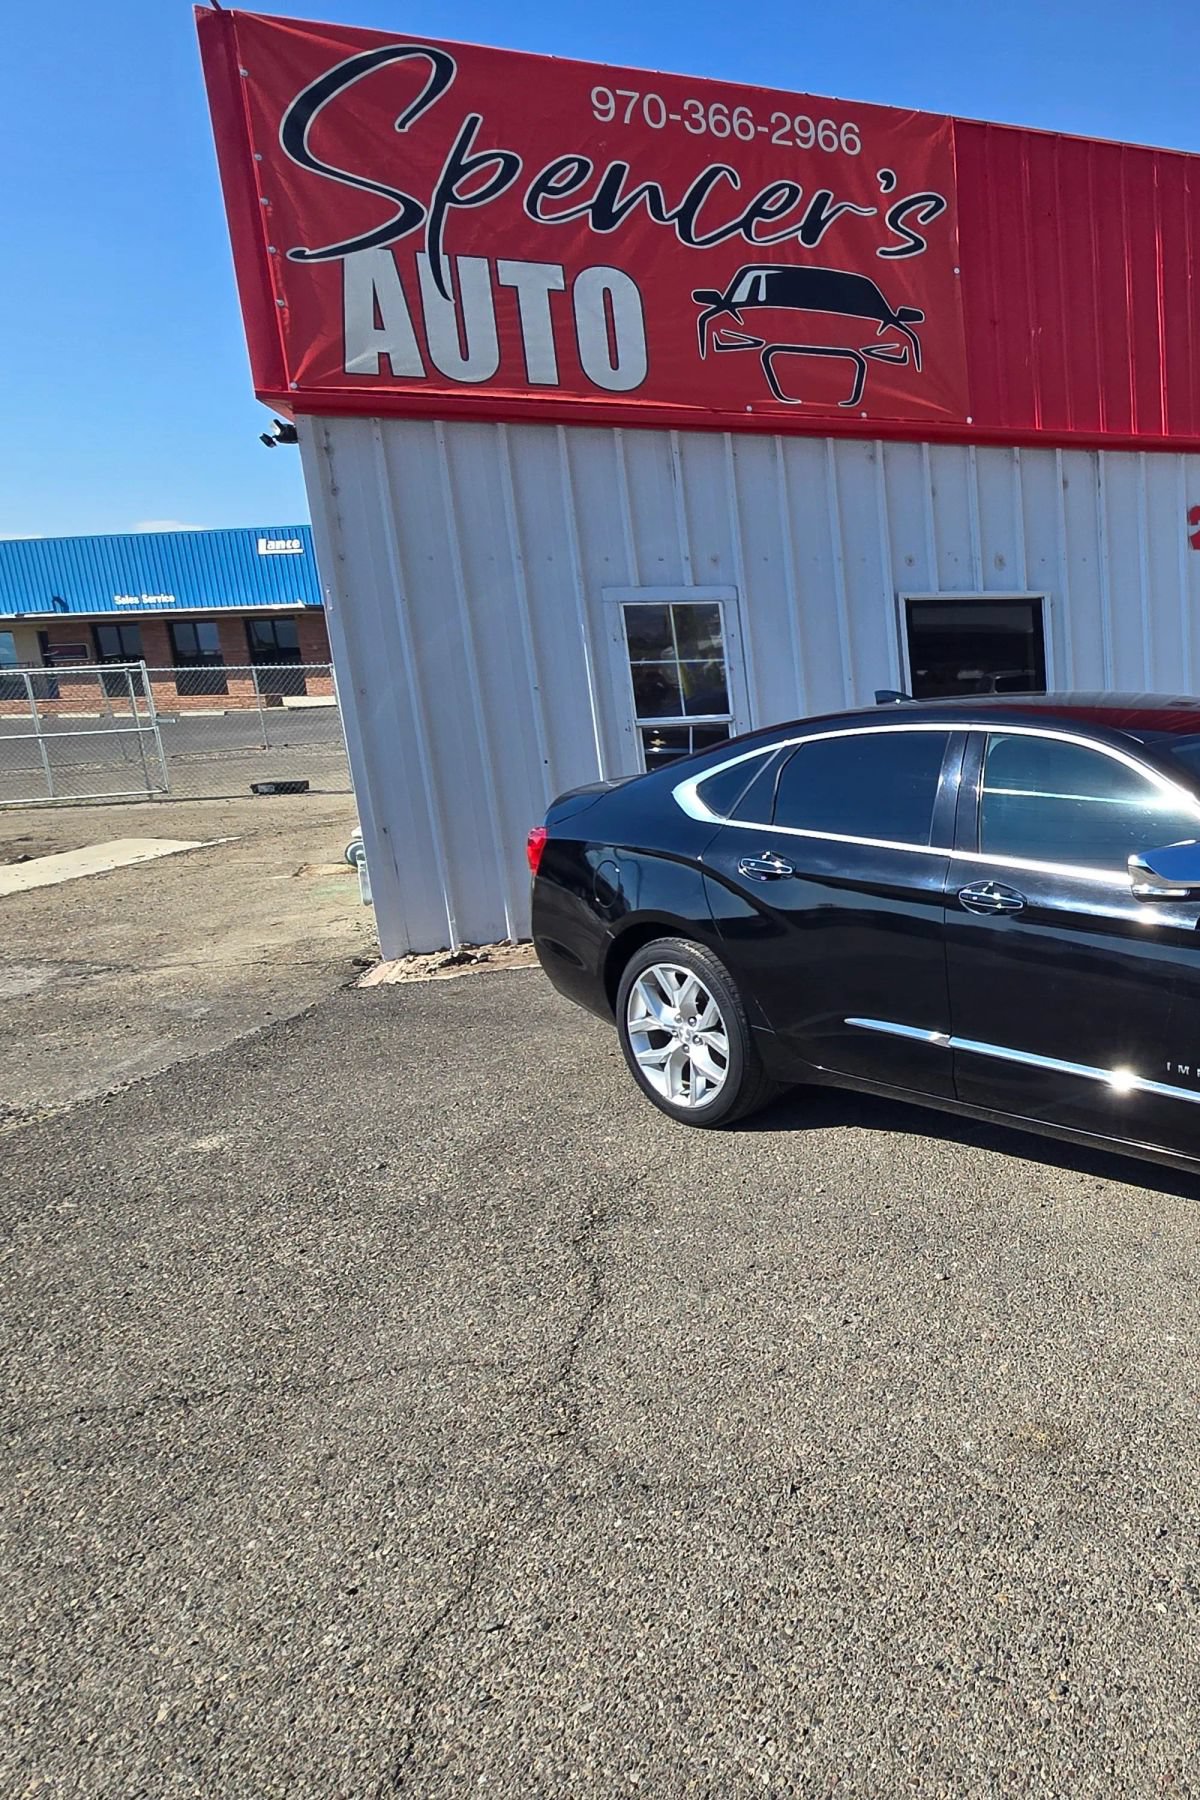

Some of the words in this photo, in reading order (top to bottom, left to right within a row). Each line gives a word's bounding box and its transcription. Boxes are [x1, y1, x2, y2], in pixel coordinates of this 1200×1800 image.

[590, 86, 862, 157] 970-366-2966
[279, 43, 948, 304] Spencer's
[342, 247, 649, 392] AUTO
[258, 538, 303, 554] Lance
[114, 595, 140, 605] Sales
[142, 594, 175, 604] Service
